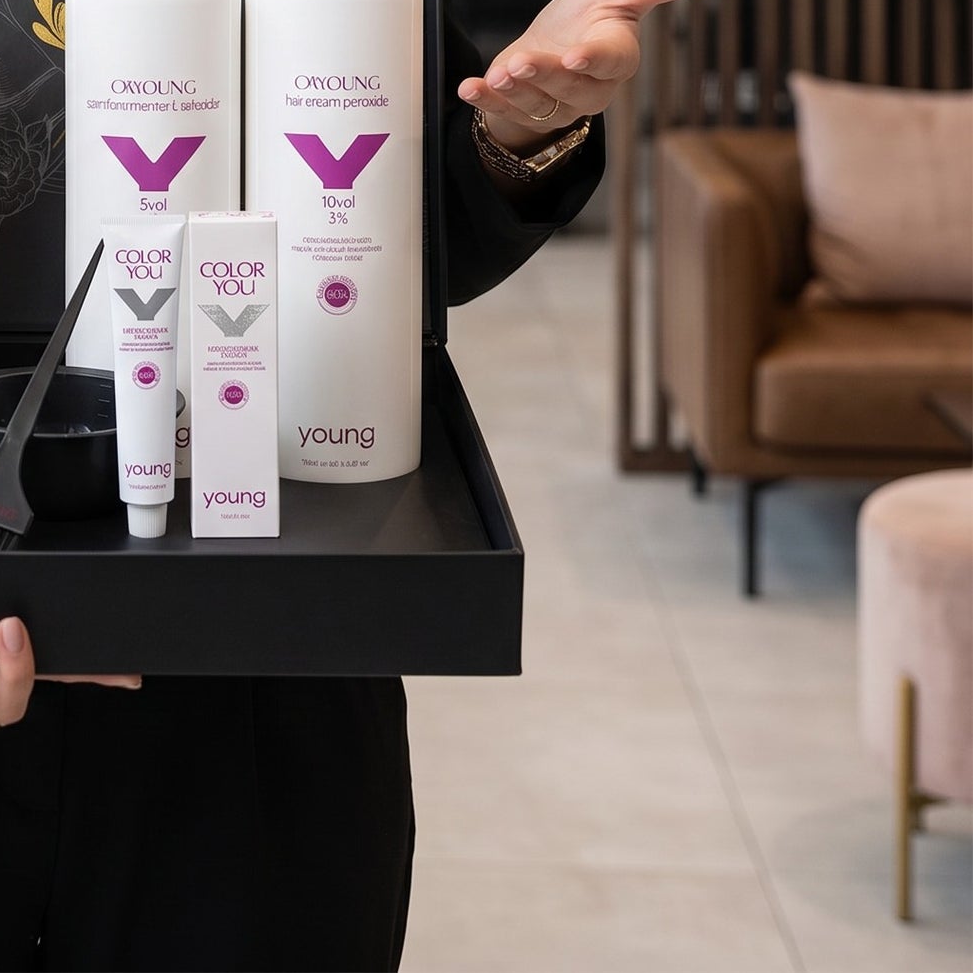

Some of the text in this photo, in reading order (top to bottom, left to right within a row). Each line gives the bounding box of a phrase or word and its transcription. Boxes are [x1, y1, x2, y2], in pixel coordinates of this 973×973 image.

[285, 94, 303, 107] hair
[343, 94, 389, 110] peroxide
[140, 197, 167, 212] 5vol
[322, 195, 355, 209] 10vol
[328, 212, 348, 226] 3%
[115, 249, 172, 264] COLOR
[126, 265, 163, 280] YOU
[200, 262, 265, 278] COLOR
[212, 280, 255, 296] YOU
[298, 426, 375, 449] young
[125, 462, 172, 478] young
[203, 491, 266, 509] young
